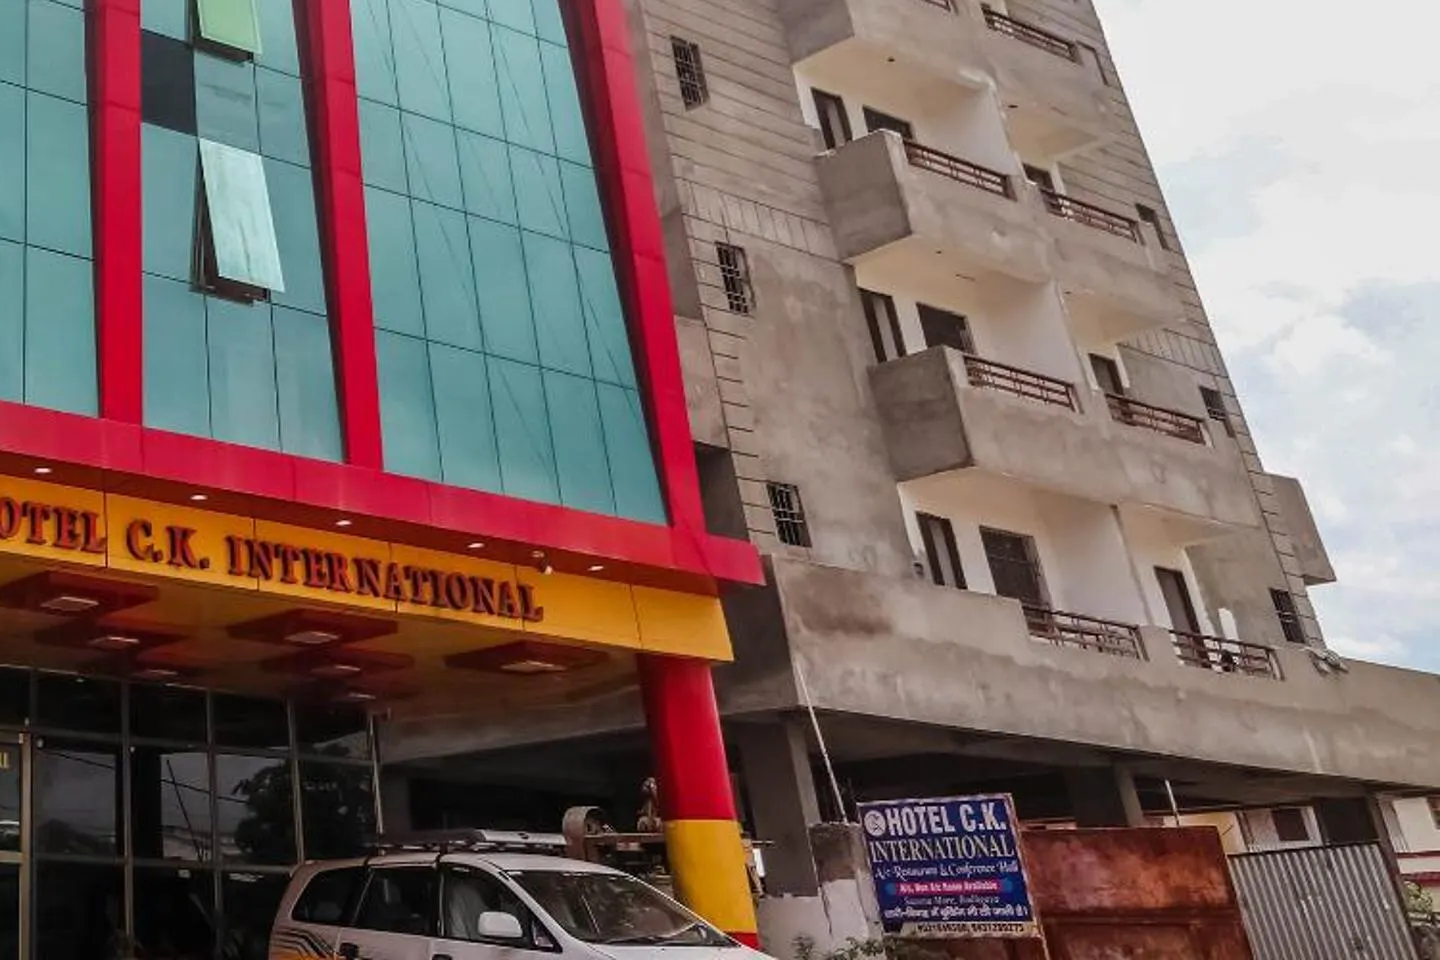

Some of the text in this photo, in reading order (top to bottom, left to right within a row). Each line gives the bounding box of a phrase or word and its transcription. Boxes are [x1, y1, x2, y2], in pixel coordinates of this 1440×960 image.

[126, 518, 210, 570] C.K.
[224, 534, 544, 622] INTERNATIONAL
[884, 802, 1007, 836] HOTEL C.K.
[868, 834, 1015, 863] INTERNATIONAL
